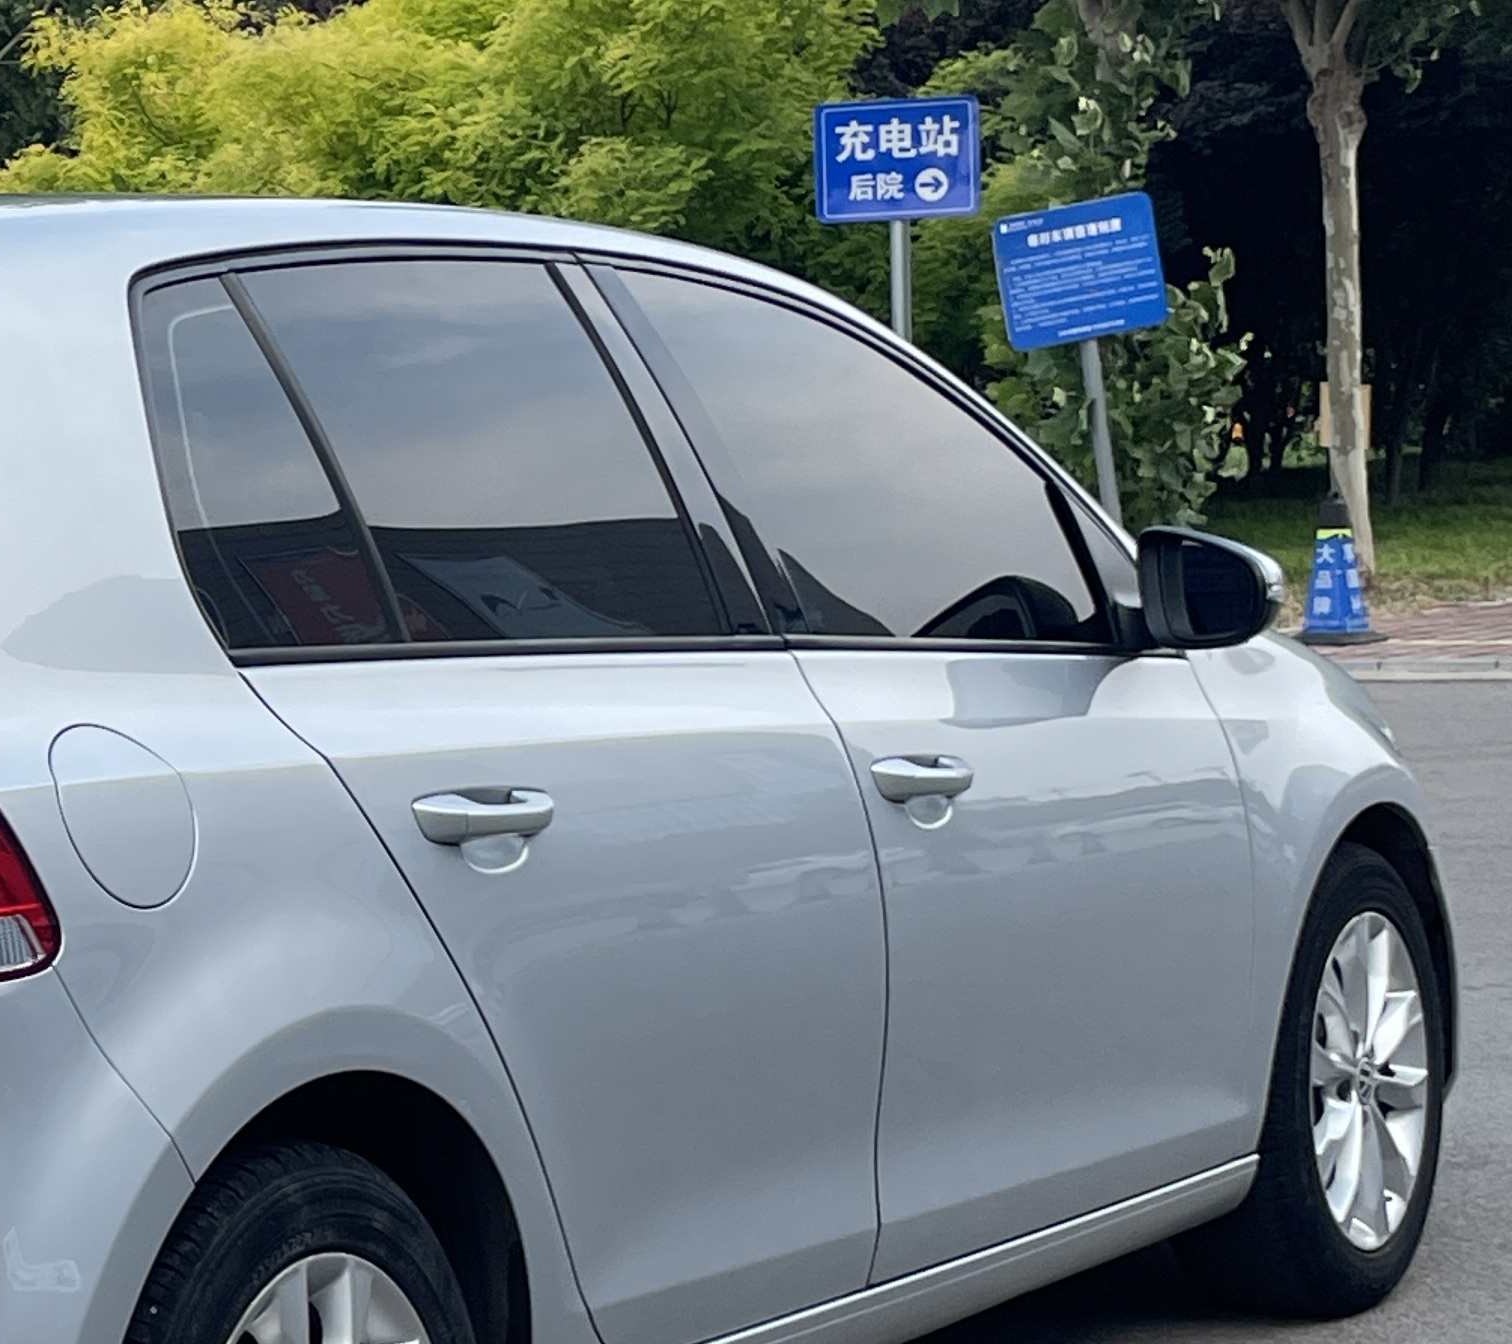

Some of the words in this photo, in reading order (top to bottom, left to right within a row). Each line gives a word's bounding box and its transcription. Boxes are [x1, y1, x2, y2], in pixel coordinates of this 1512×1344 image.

[834, 114, 960, 163] 充电站
[848, 171, 905, 201] 后院
